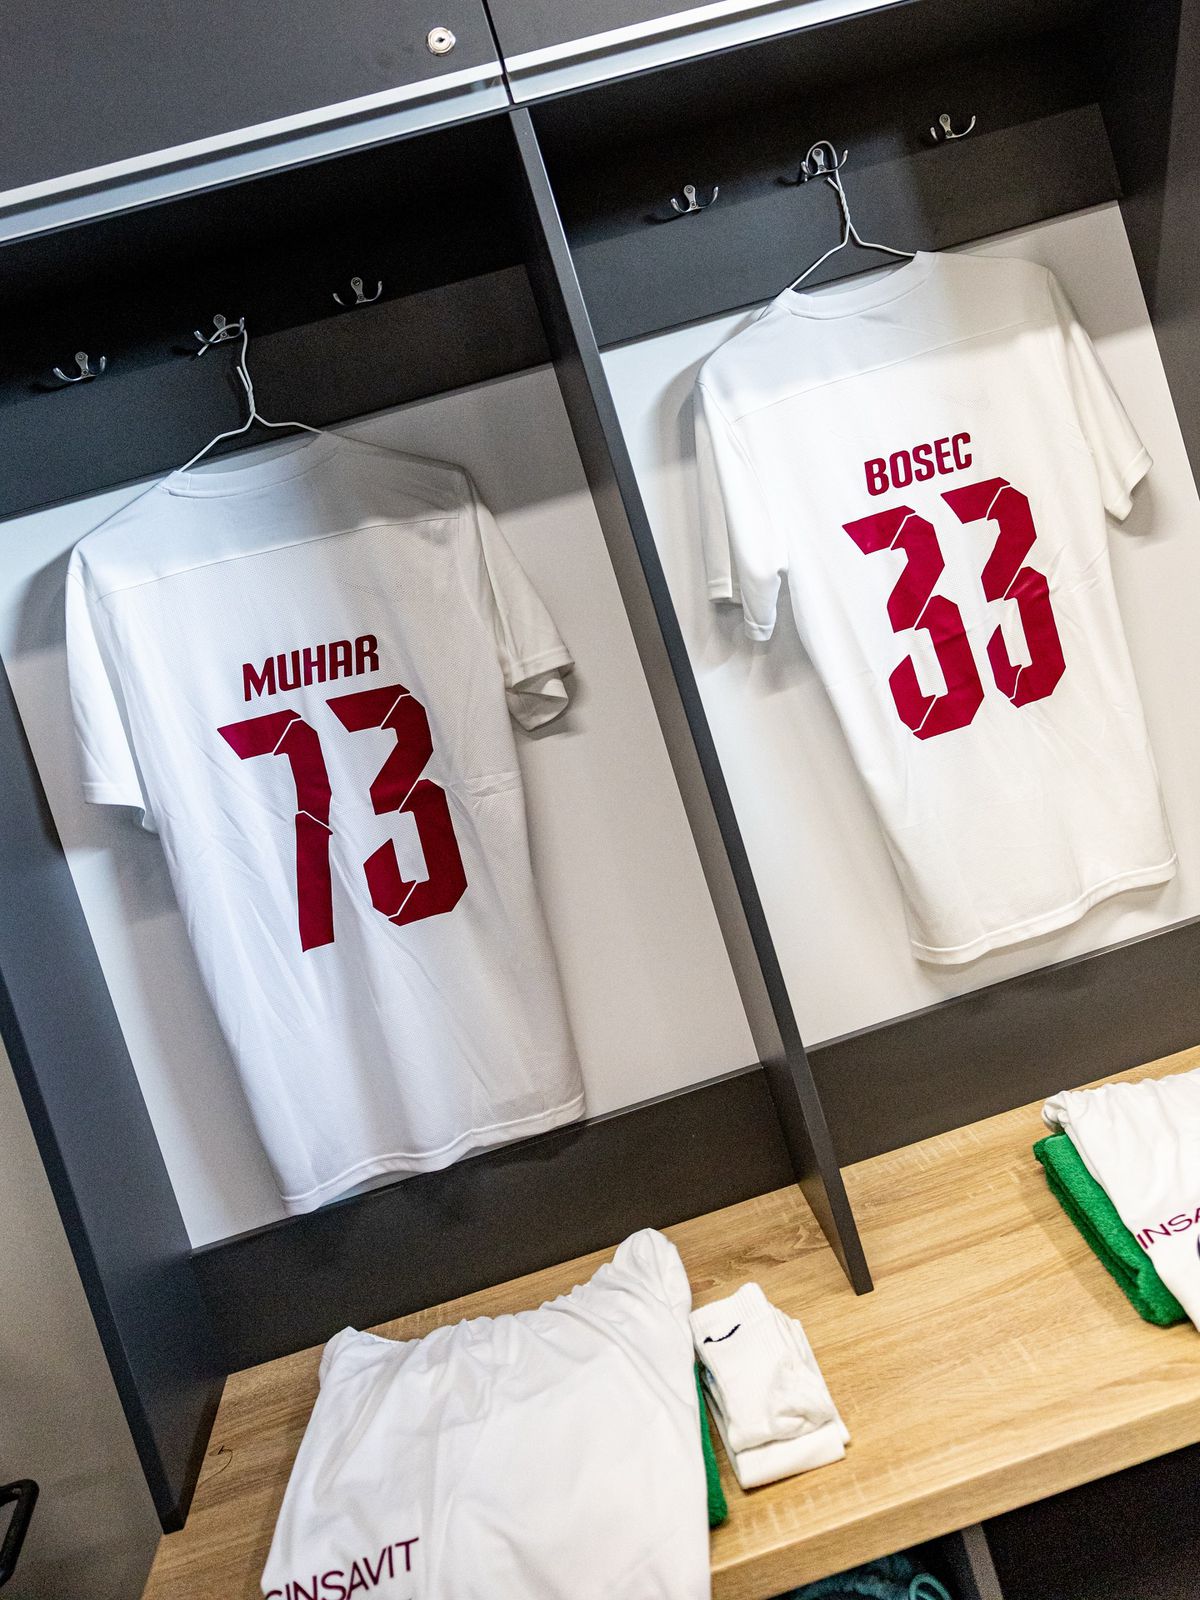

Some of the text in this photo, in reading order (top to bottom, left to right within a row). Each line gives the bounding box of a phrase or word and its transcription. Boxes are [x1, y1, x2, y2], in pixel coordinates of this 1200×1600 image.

[864, 432, 973, 497] BOSEC
[242, 634, 380, 702] MUHAR
[841, 476, 1067, 741] 33
[217, 683, 469, 953] 73
